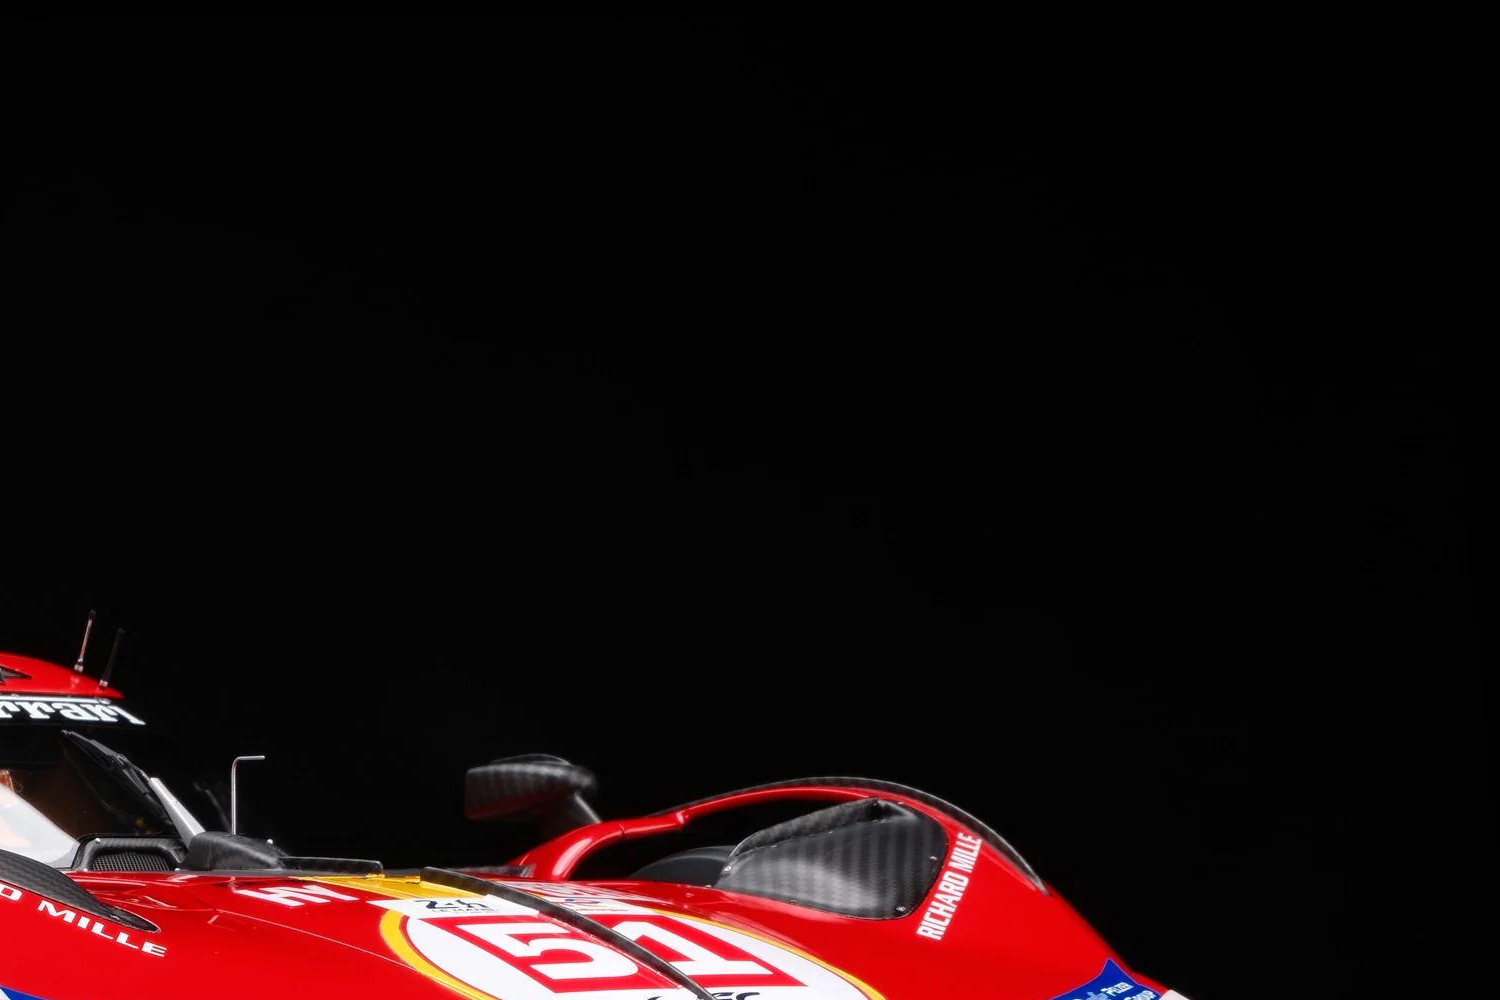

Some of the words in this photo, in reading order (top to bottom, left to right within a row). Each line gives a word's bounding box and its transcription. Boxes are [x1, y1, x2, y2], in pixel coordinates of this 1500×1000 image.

[916, 871, 970, 941] RICHARD
[948, 832, 982, 874] MILLE
[37, 899, 168, 958] MILLE
[452, 919, 778, 982] 51
